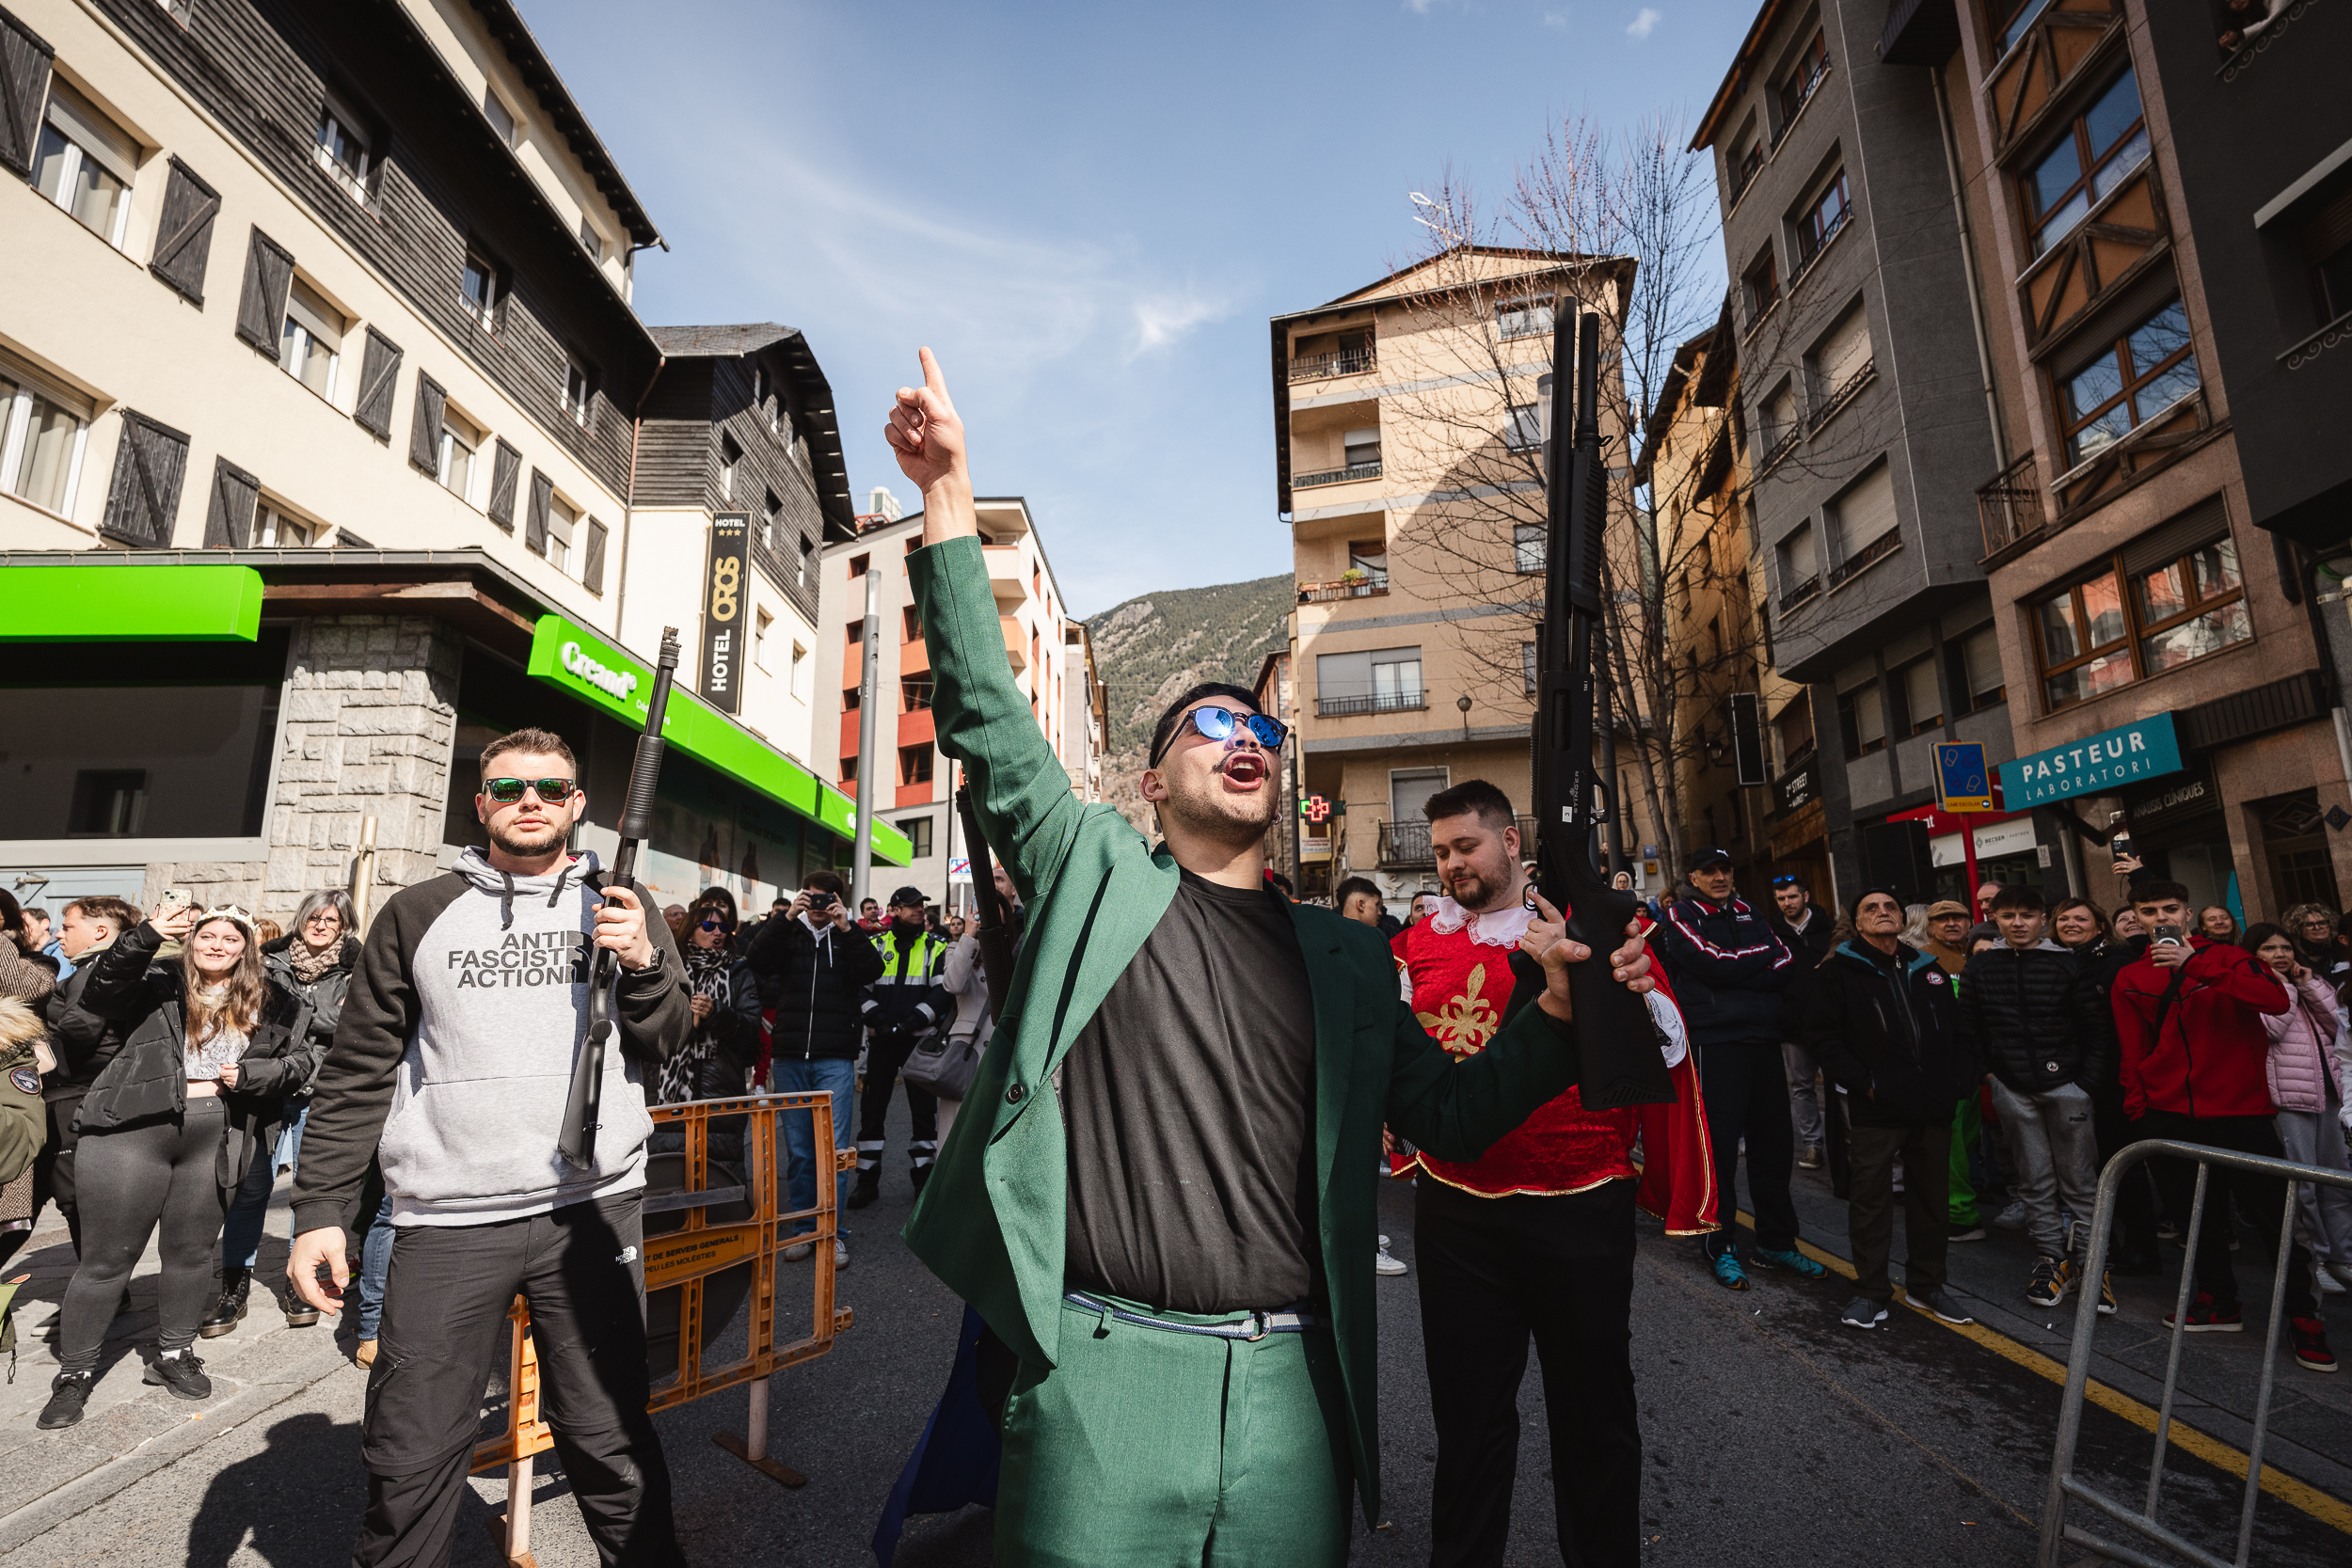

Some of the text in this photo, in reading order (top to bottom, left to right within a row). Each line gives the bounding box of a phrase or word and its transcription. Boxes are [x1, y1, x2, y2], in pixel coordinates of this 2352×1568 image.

[715, 518, 745, 528] HOTEL
[711, 556, 740, 691] HOTEL OROS
[2023, 731, 2146, 784] PASTEUR
[1791, 771, 1807, 793] STREET
[2026, 757, 2151, 800] LABORATORI
[2134, 781, 2204, 819] ANÀLISIS CLÍNIQUES
[2331, 812, 2341, 823] 8
[501, 930, 565, 950] ANTI
[448, 947, 564, 969] FASCIST
[457, 966, 564, 989] ACTION
[653, 1253, 664, 1261] DE
[665, 1244, 698, 1258] SERVEIS
[699, 1234, 739, 1249] GENERALS
[660, 1260, 675, 1270] LES
